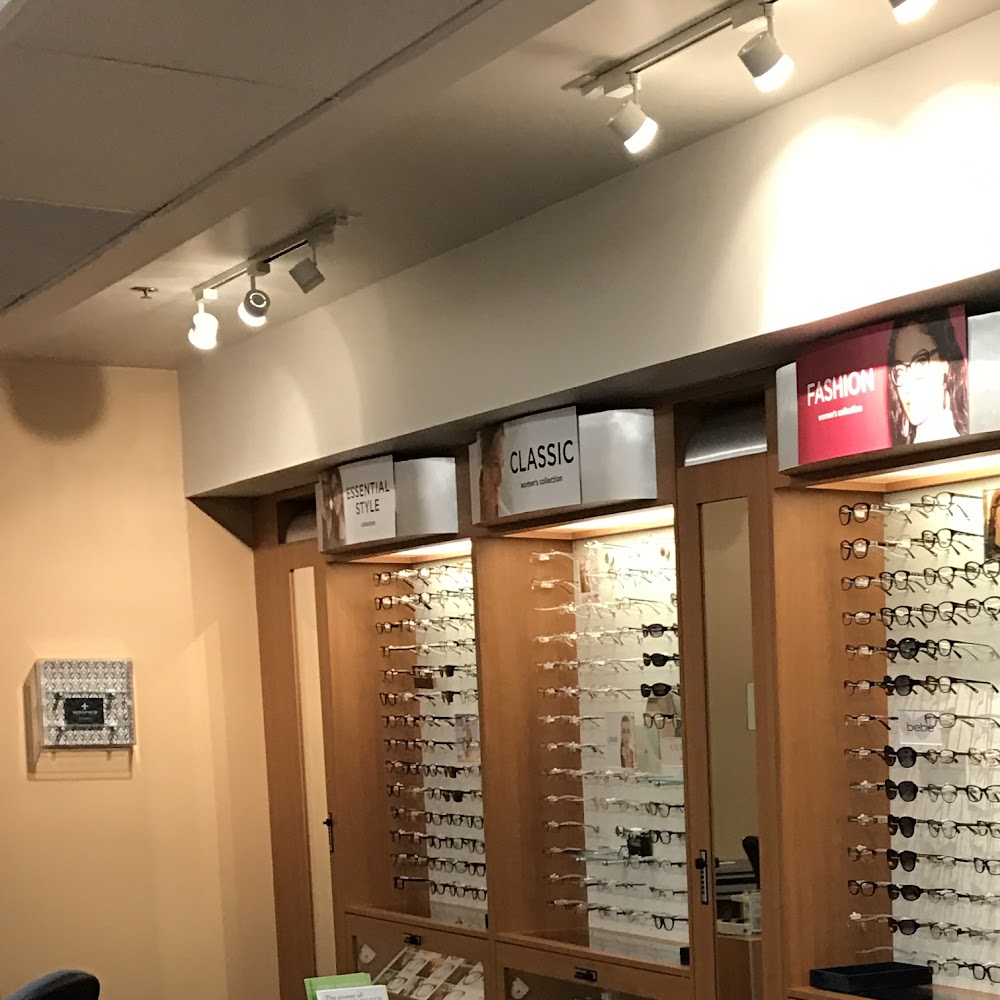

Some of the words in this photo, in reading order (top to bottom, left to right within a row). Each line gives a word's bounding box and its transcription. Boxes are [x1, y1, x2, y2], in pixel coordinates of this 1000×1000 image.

[807, 367, 875, 406] FASHION
[509, 439, 575, 474] CLASSIC
[346, 480, 390, 500] ESSENTIAL
[355, 499, 380, 515] STYLE
[907, 723, 934, 733] bebe
